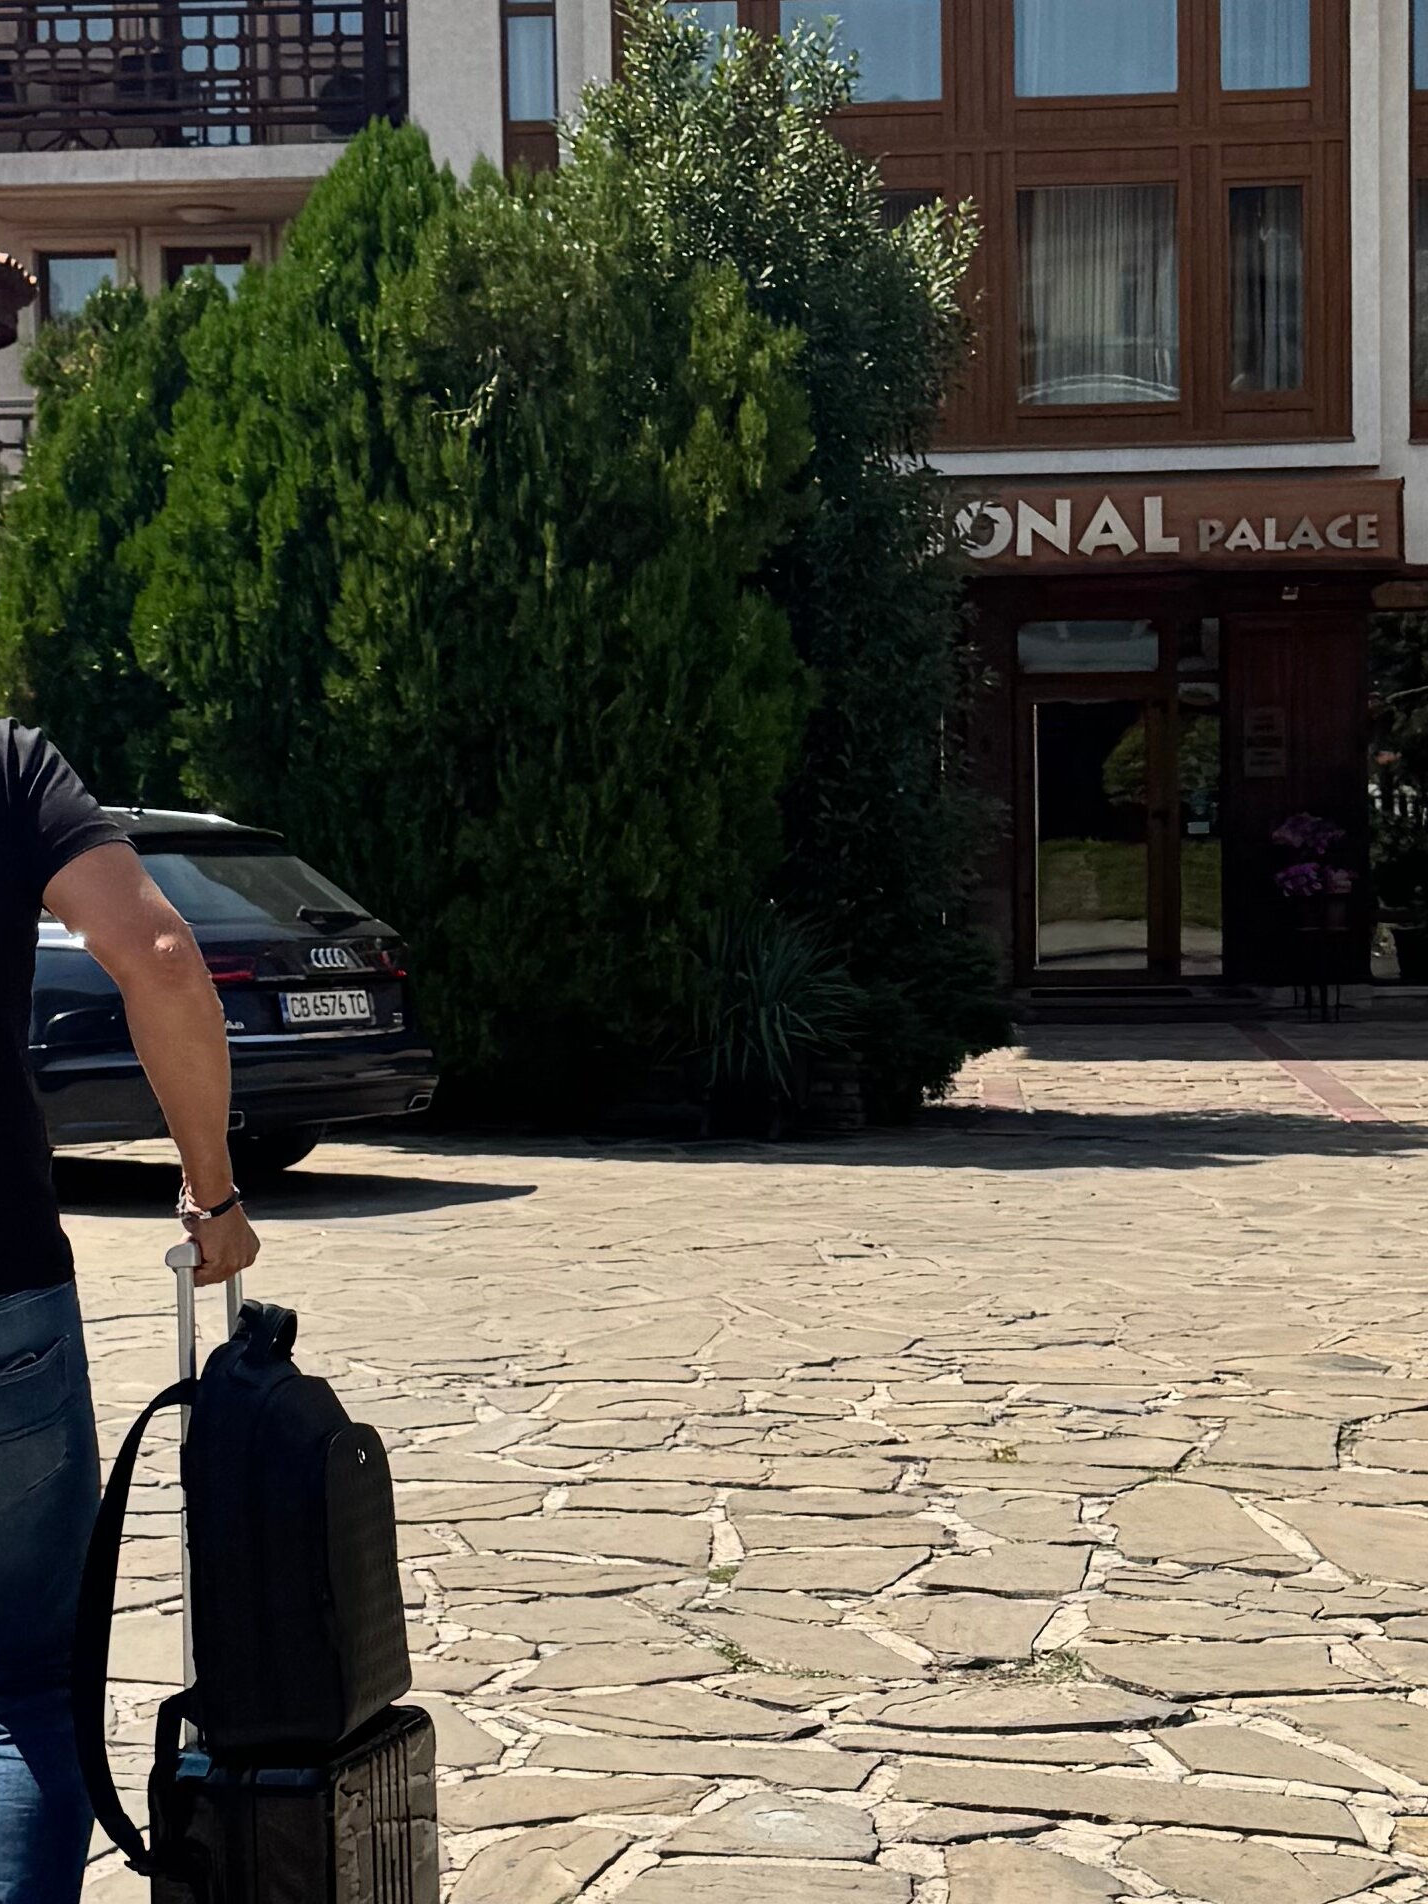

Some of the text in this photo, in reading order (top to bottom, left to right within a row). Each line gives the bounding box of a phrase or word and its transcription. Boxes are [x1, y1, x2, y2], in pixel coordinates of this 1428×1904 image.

[926, 494, 1379, 559] ONAL PALACE
[290, 993, 367, 1019] CB 6576 TC
